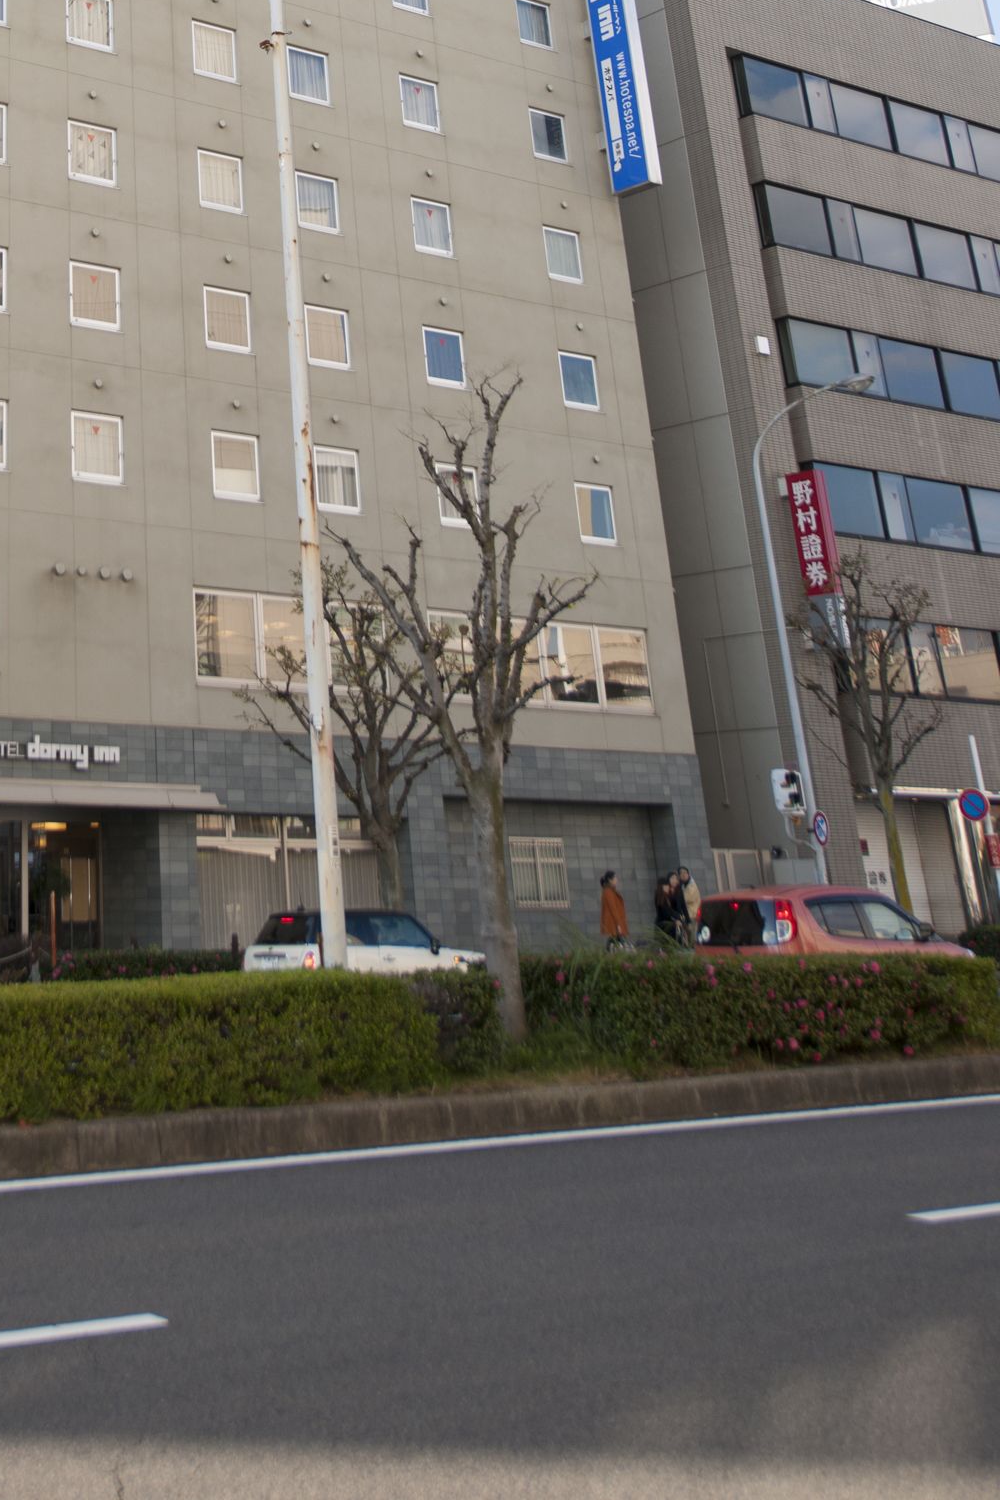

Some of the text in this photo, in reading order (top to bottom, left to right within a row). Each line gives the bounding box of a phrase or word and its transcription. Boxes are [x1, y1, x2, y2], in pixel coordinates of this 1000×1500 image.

[597, 3, 615, 42] inn
[616, 52, 642, 158] www.hotespa.net/
[791, 479, 828, 587] 野村證券
[27, 734, 89, 769] dormy
[94, 745, 120, 763] inn
